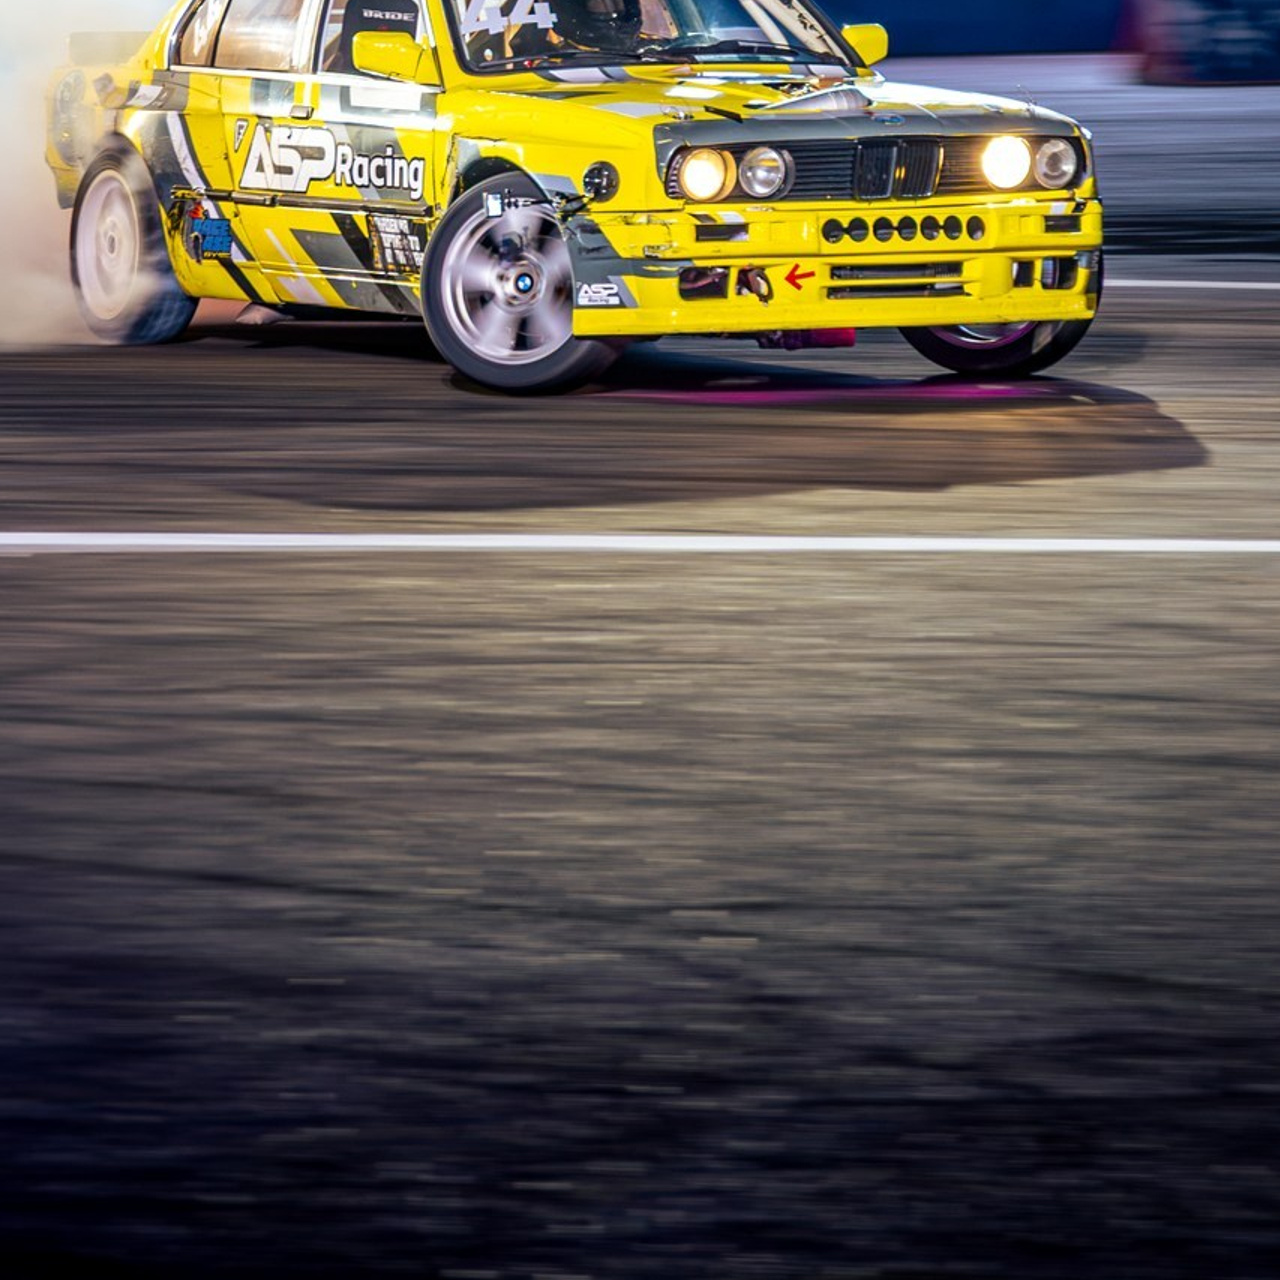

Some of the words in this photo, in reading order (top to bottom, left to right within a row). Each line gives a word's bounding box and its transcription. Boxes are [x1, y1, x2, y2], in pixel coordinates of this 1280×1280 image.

[362, 8, 416, 21] BRIDE
[239, 123, 337, 193] ASP
[335, 143, 425, 200] Racing
[578, 283, 619, 297] ASP
